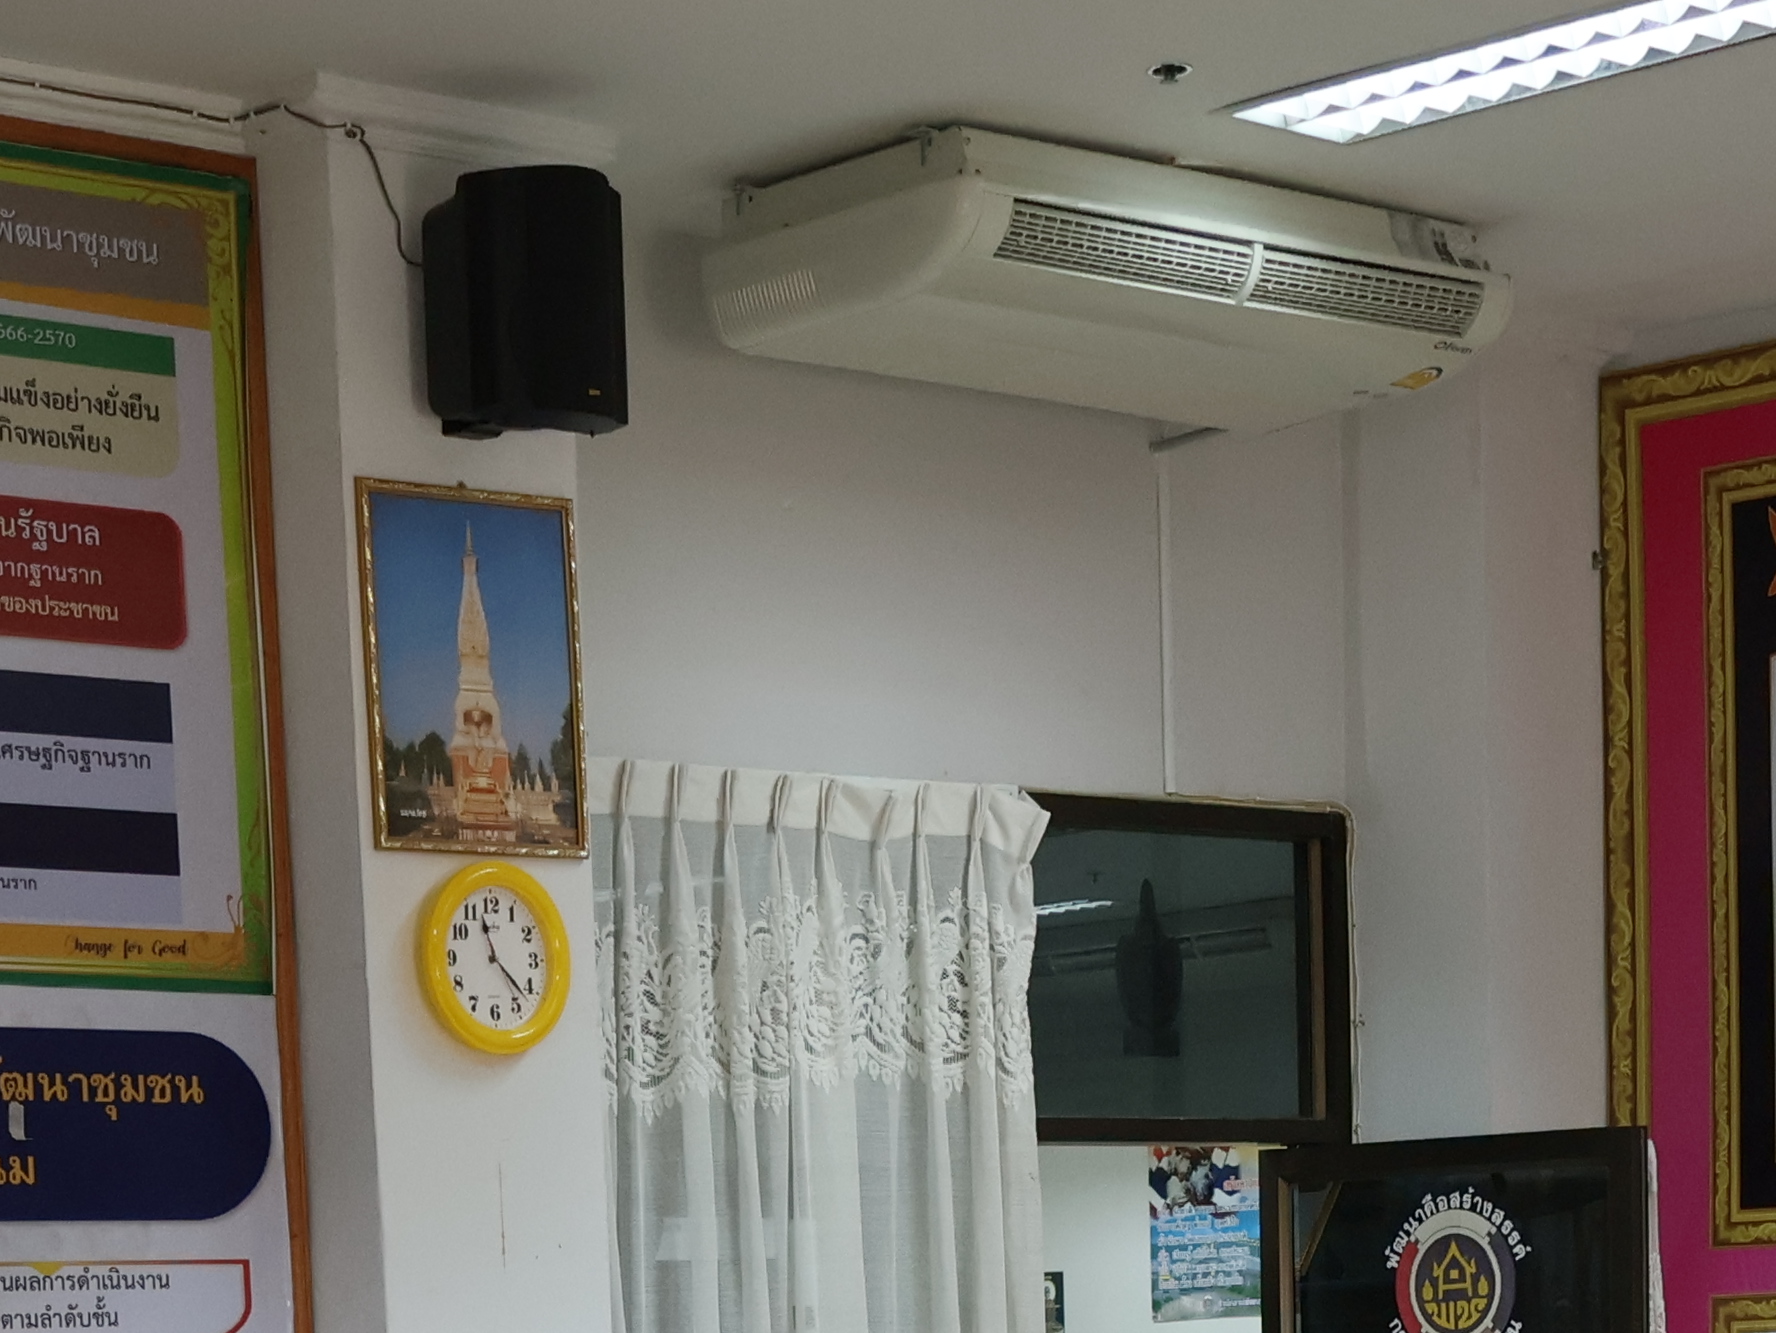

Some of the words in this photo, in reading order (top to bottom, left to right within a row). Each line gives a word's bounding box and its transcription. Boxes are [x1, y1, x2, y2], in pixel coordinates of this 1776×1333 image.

[1385, 1186, 1532, 1270] พัฒนาคือสร้างสรรค์
